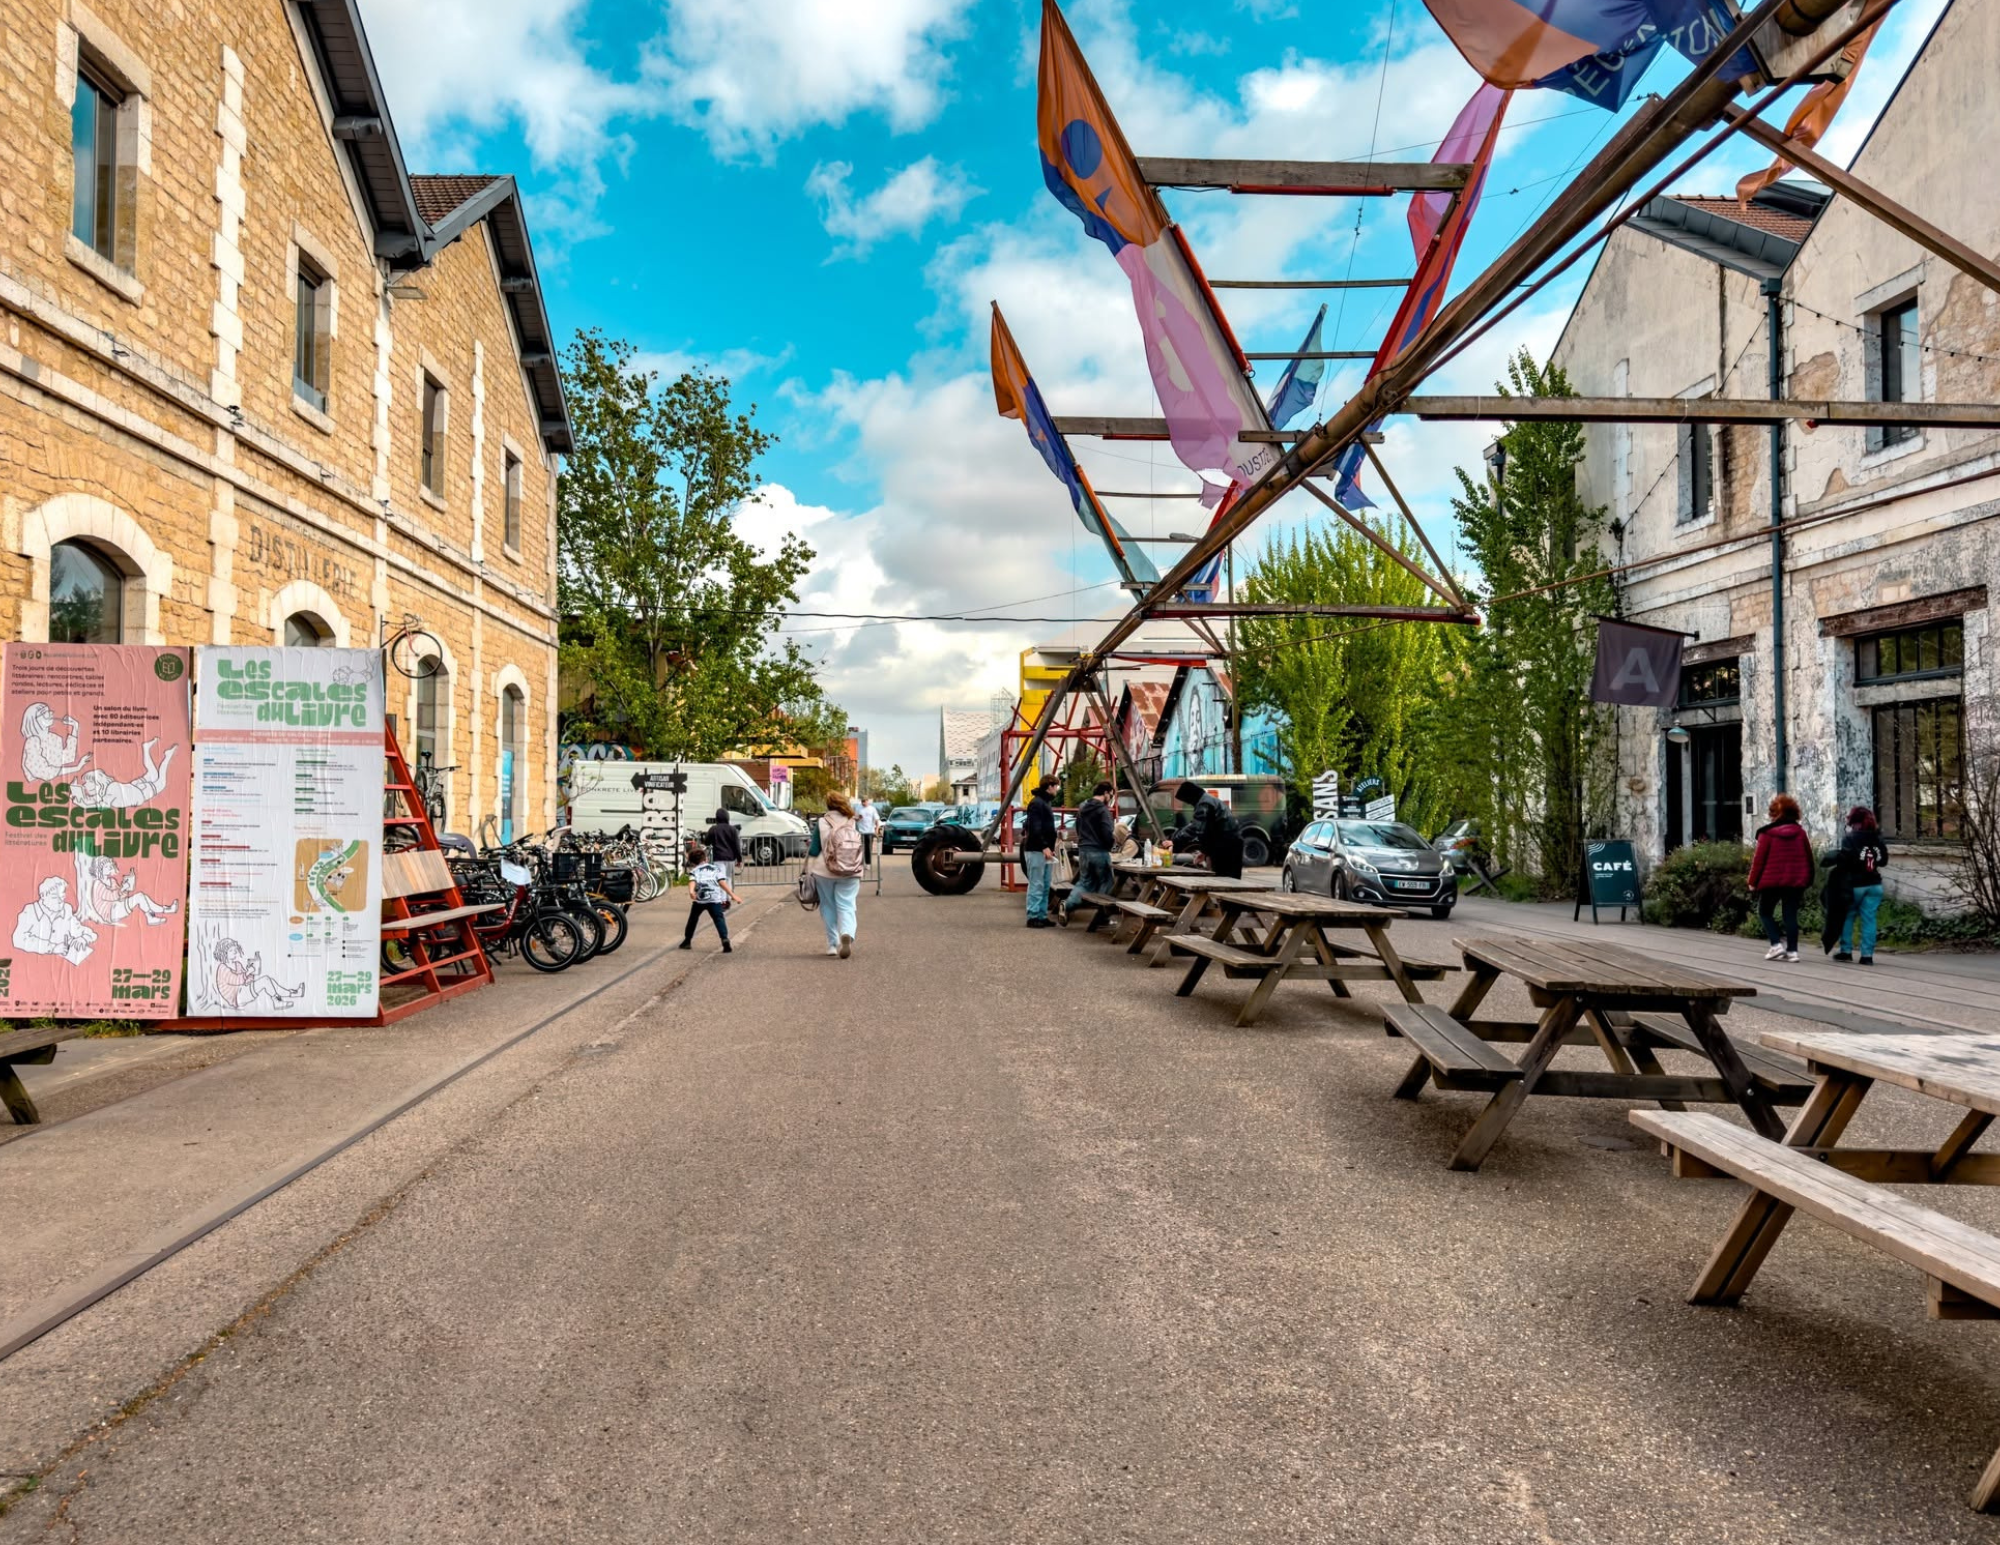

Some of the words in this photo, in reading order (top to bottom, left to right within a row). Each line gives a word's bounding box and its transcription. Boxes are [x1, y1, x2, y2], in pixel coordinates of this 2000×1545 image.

[217, 659, 271, 679] Les
[1609, 647, 1660, 693] A
[7, 781, 71, 804] Les
[1356, 778, 1380, 793] ATELIERS
[1592, 860, 1632, 871] CAFÉ
[112, 985, 170, 999] mars
[326, 983, 372, 994] mars
[326, 995, 357, 1006] 2026
